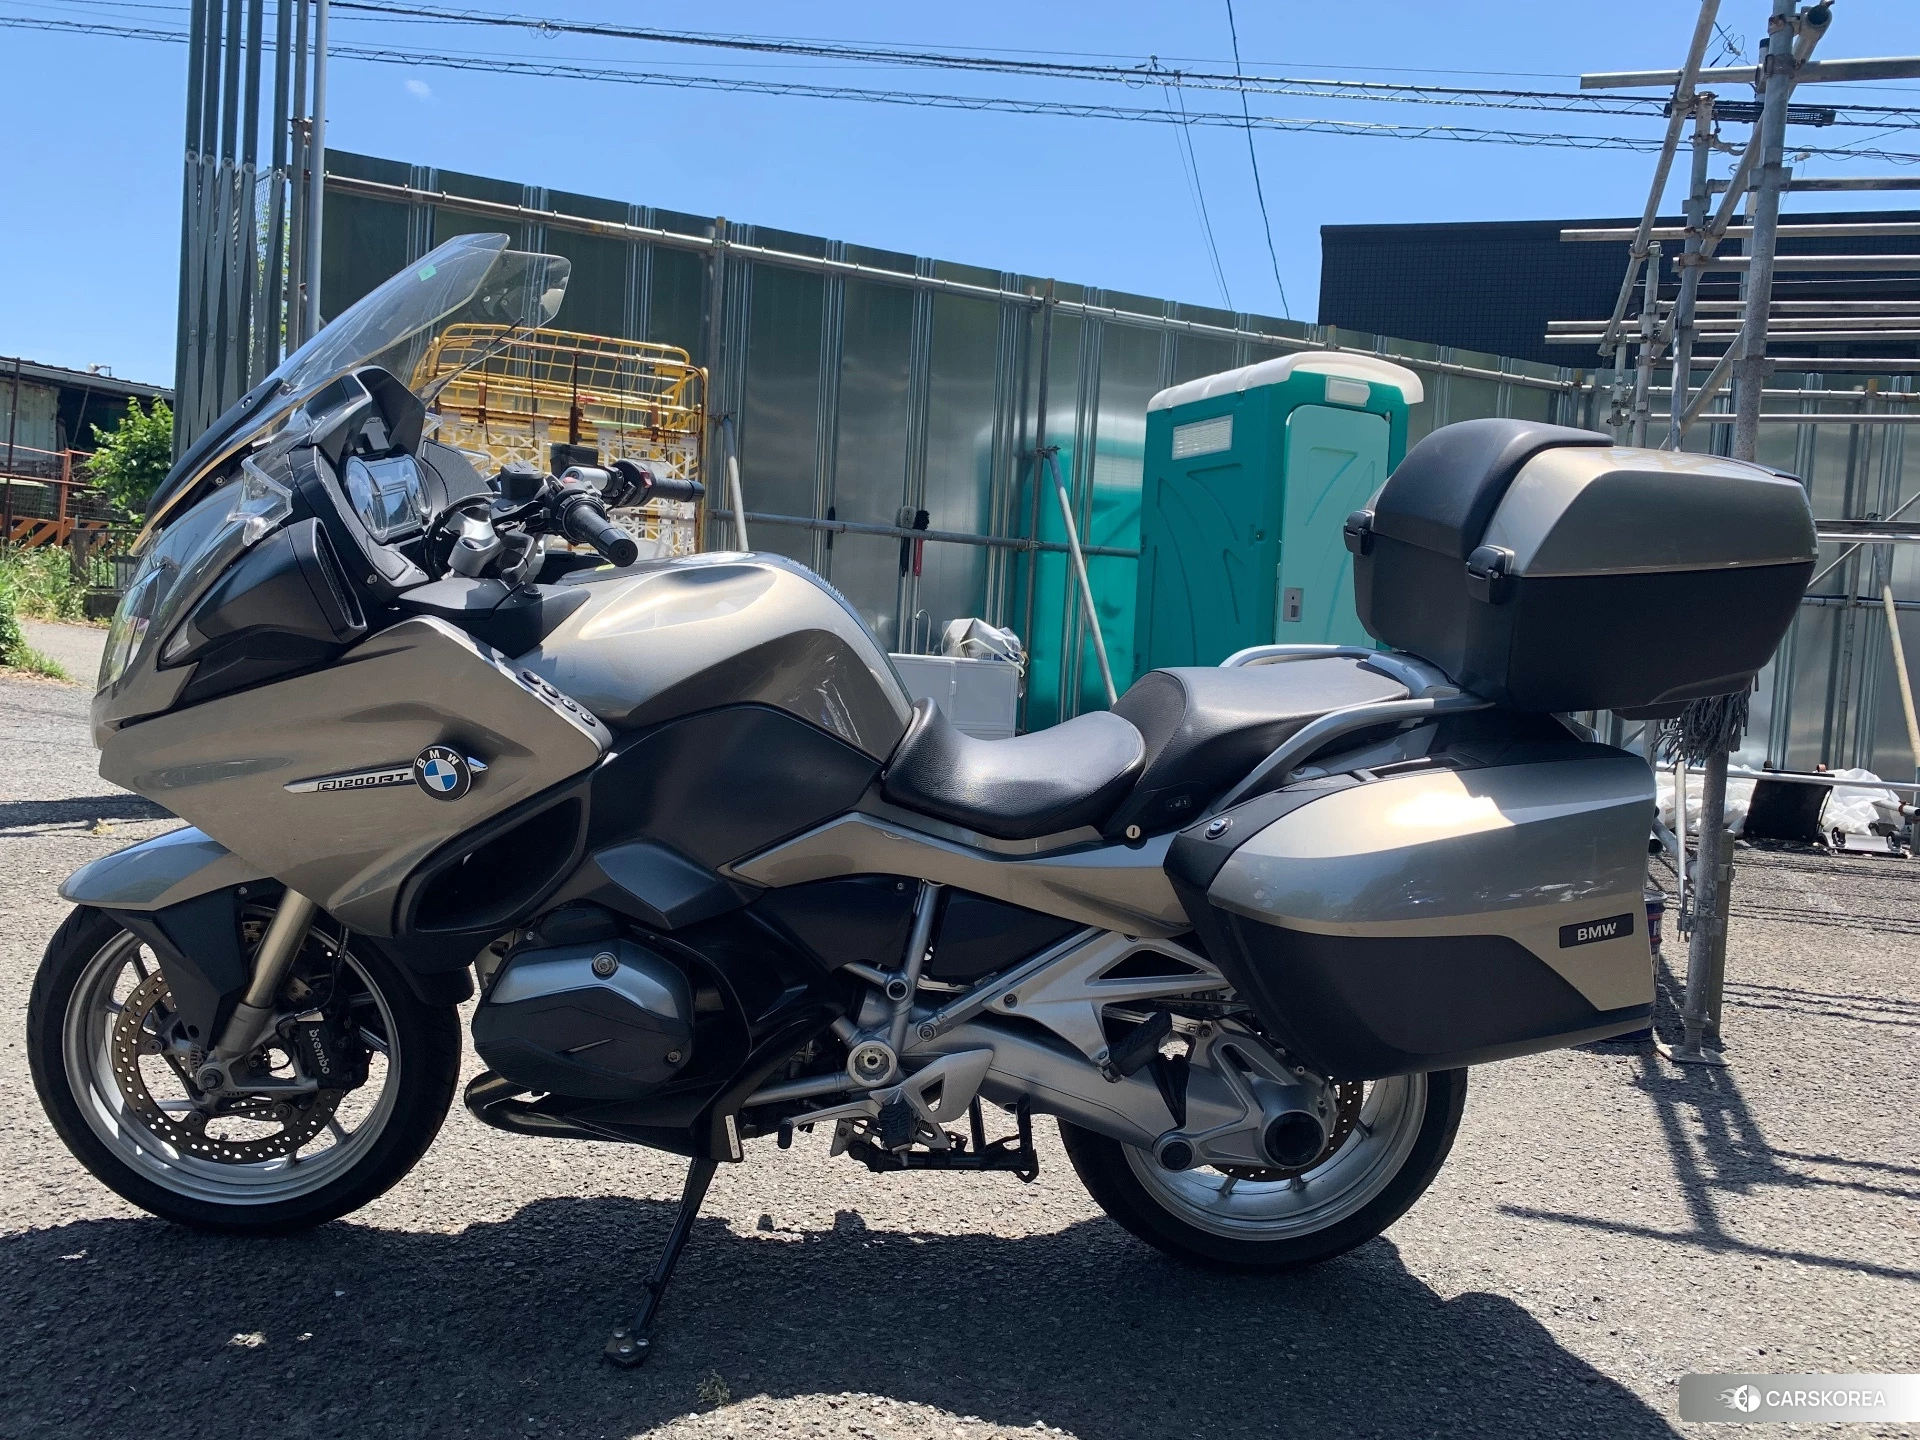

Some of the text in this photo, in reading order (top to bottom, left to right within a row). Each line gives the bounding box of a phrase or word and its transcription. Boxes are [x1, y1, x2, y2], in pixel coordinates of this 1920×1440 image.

[416, 749, 460, 770] BMW
[1577, 922, 1617, 941] BMW
[309, 1028, 330, 1075] brembo
